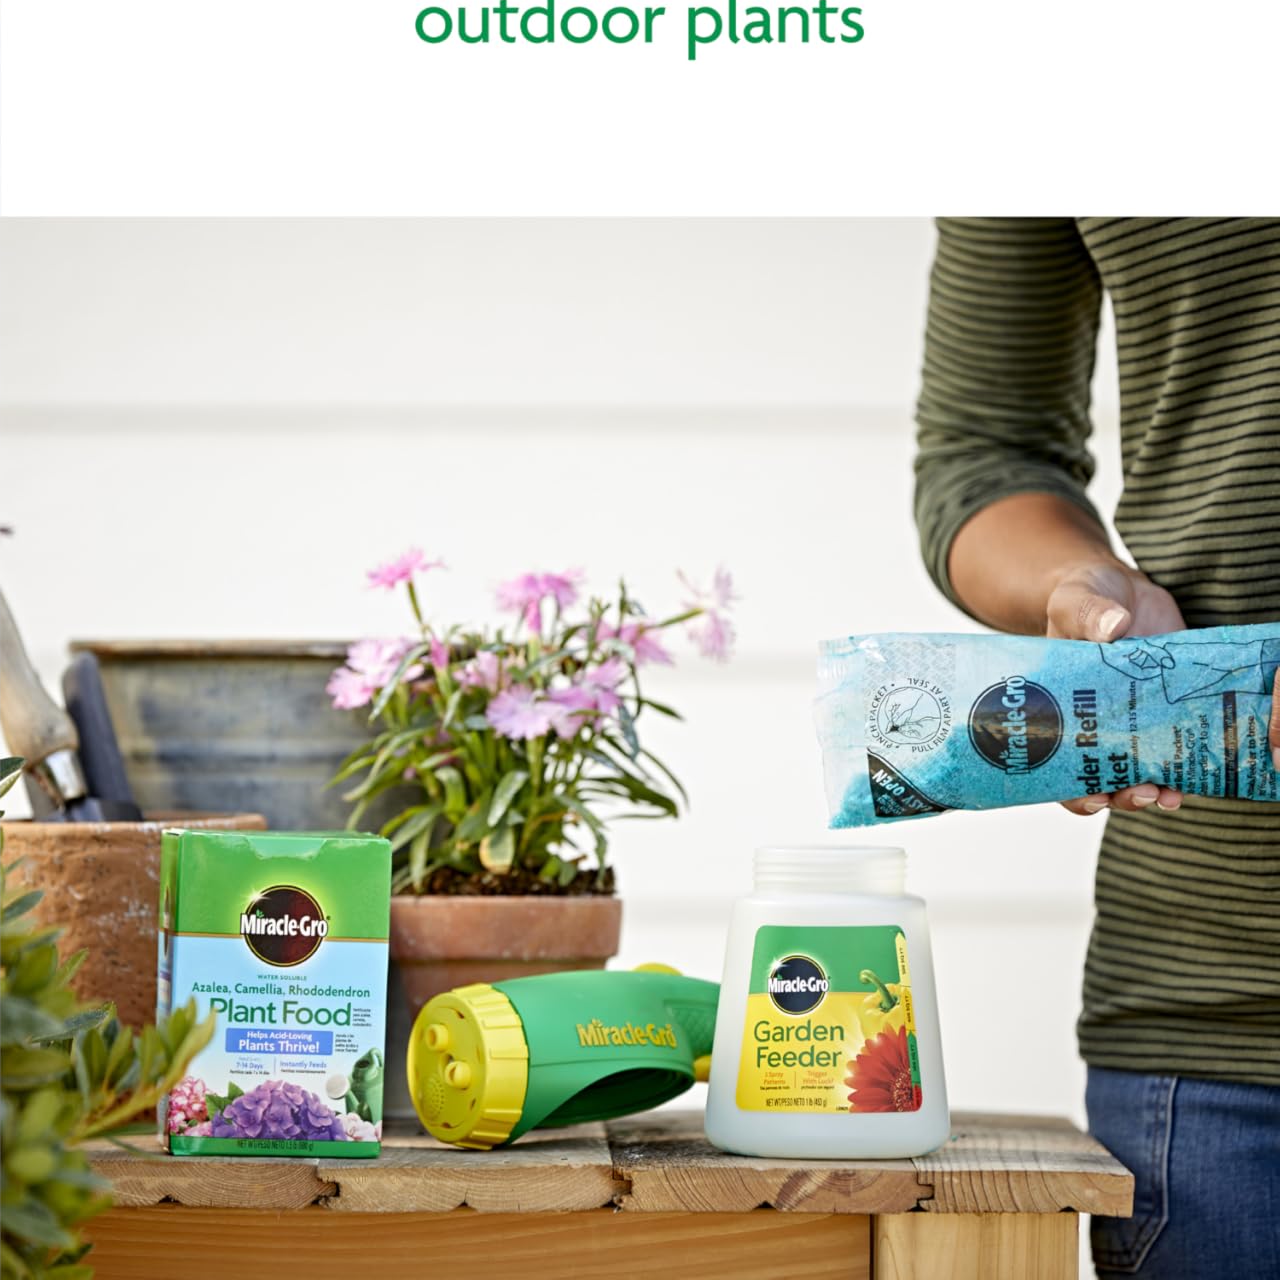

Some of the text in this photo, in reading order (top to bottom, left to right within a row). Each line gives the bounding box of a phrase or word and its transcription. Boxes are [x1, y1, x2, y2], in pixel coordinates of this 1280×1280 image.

[907, 678, 930, 689] SEAL
[1128, 680, 1137, 711] Minutes
[869, 685, 892, 750] PINCH PACKET
[938, 696, 953, 726] APART
[1073, 688, 1097, 748] Refill
[911, 744, 934, 753] PULL
[933, 728, 950, 748] FILM
[872, 769, 906, 795] OPEN
[192, 982, 371, 998] Azalea, Camellia, Rhododendron
[210, 997, 276, 1025] Plant
[283, 1000, 351, 1027] Food
[247, 1031, 313, 1043] Helps Acid-Loving
[753, 1020, 845, 1042] Garden
[239, 1040, 275, 1053] Plants
[277, 1041, 320, 1054] Thrive!
[756, 1046, 842, 1068] Feeder
